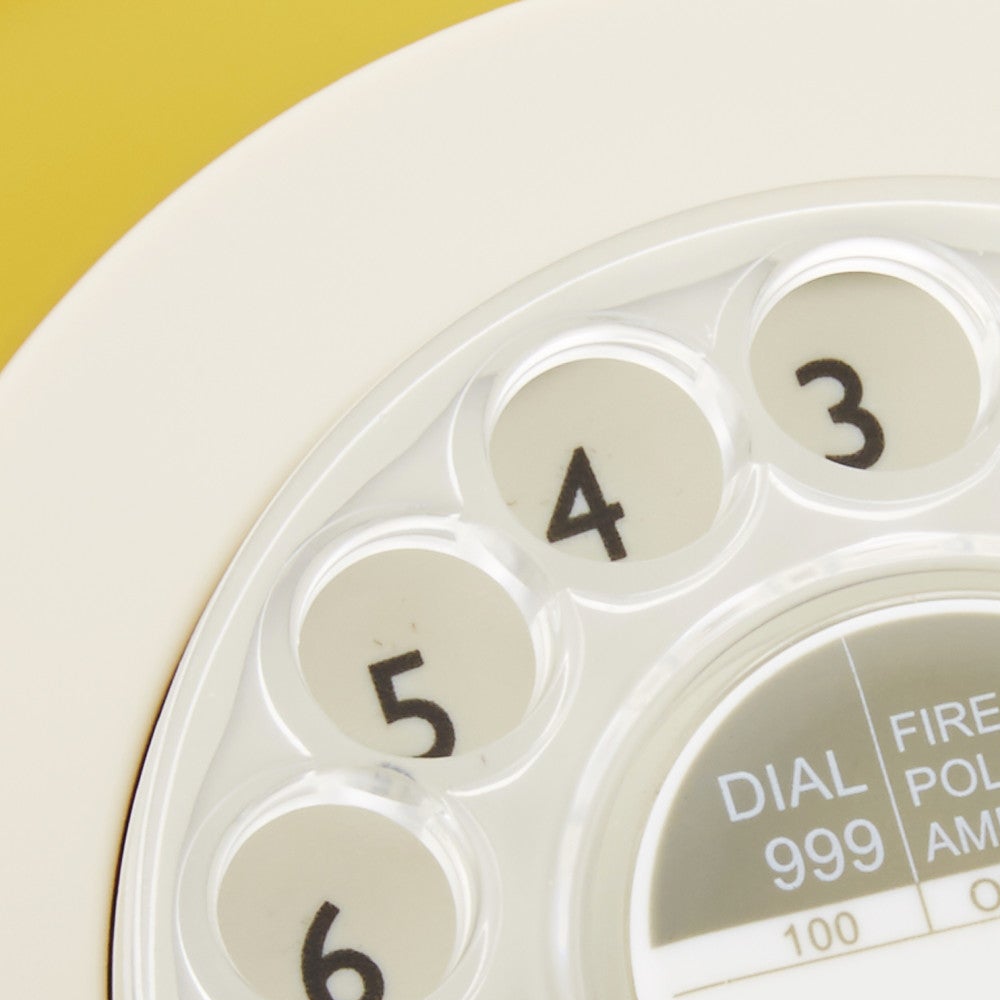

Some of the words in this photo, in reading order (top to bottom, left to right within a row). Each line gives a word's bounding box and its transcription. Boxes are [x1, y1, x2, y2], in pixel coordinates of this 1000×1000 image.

[796, 360, 885, 469] 3
[546, 447, 627, 562] 4
[368, 649, 456, 759] 5
[716, 748, 868, 823] DIAL
[763, 817, 886, 891] 999
[783, 910, 860, 957] 100
